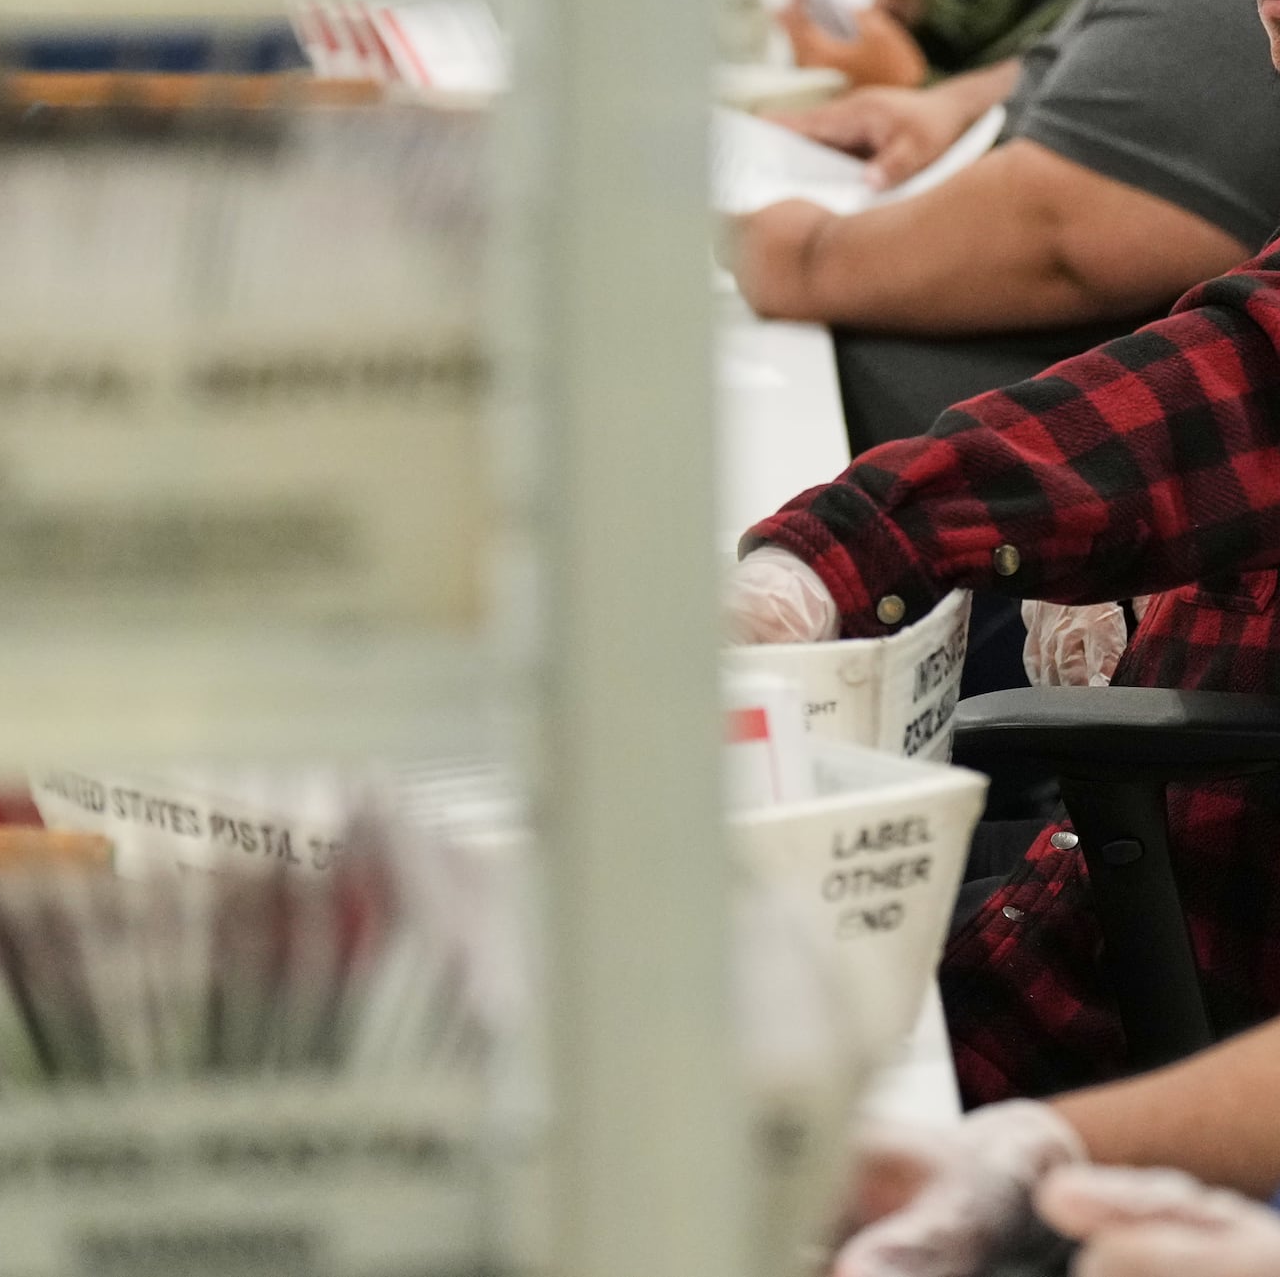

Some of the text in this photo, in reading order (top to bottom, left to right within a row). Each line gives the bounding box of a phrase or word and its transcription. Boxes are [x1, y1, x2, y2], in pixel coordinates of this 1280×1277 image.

[802, 700, 838, 717] GHT
[111, 784, 202, 840] STATES
[831, 815, 933, 861] LABEL
[821, 854, 931, 902] OTHER
[835, 901, 904, 940] END
